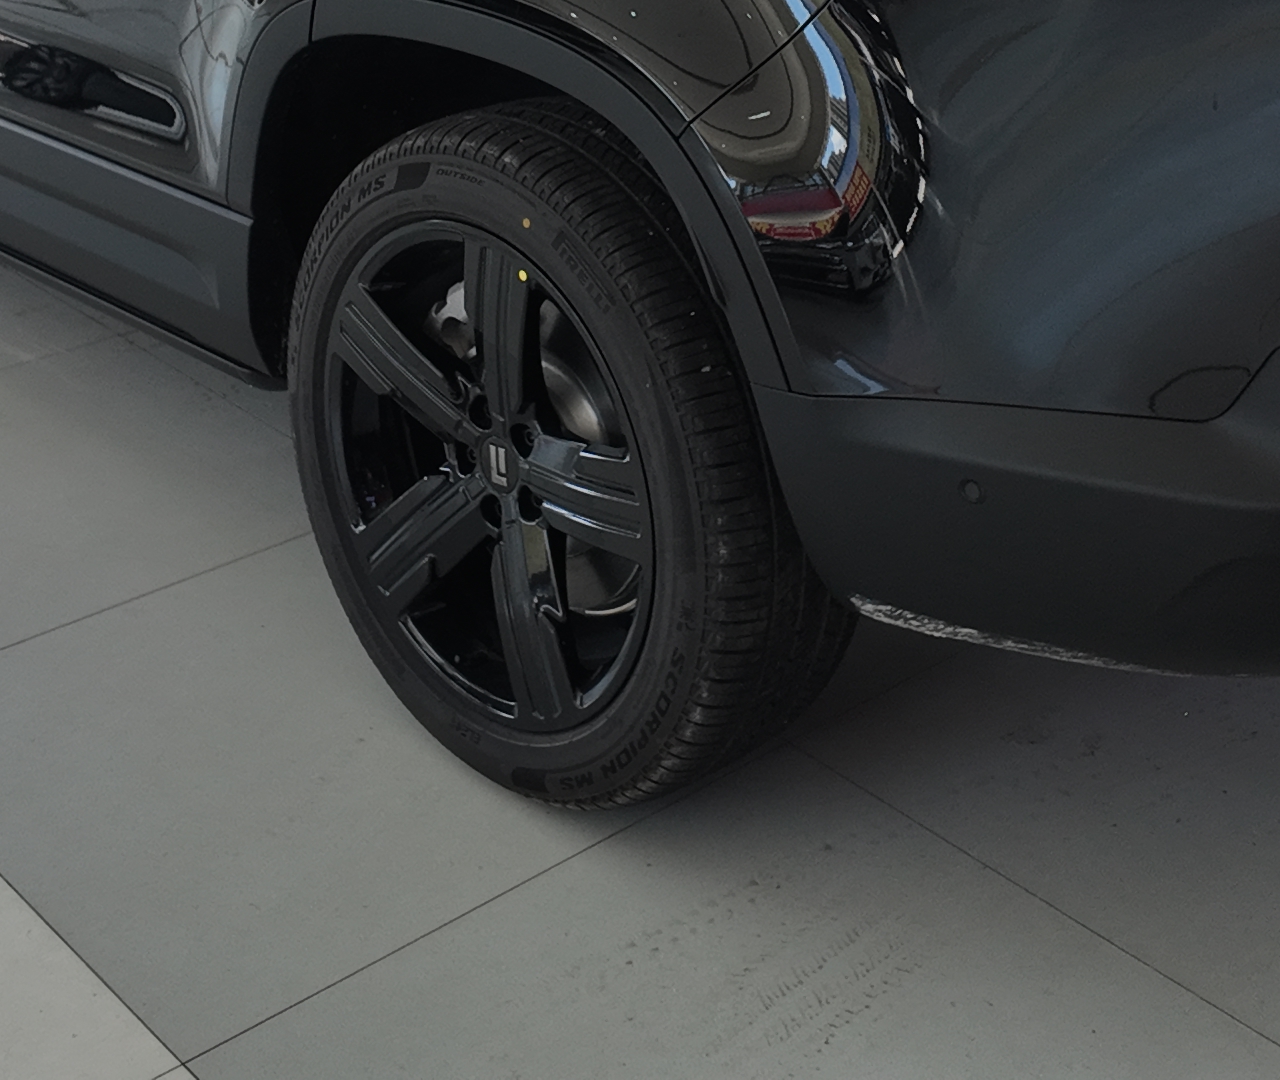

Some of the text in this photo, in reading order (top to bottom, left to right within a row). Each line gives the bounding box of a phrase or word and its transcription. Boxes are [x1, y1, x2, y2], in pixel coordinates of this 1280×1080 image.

[357, 172, 388, 204] MS
[435, 167, 487, 188] OUTSIDE
[551, 229, 617, 314] PIRELLI
[558, 645, 688, 792] SCORPION MS
